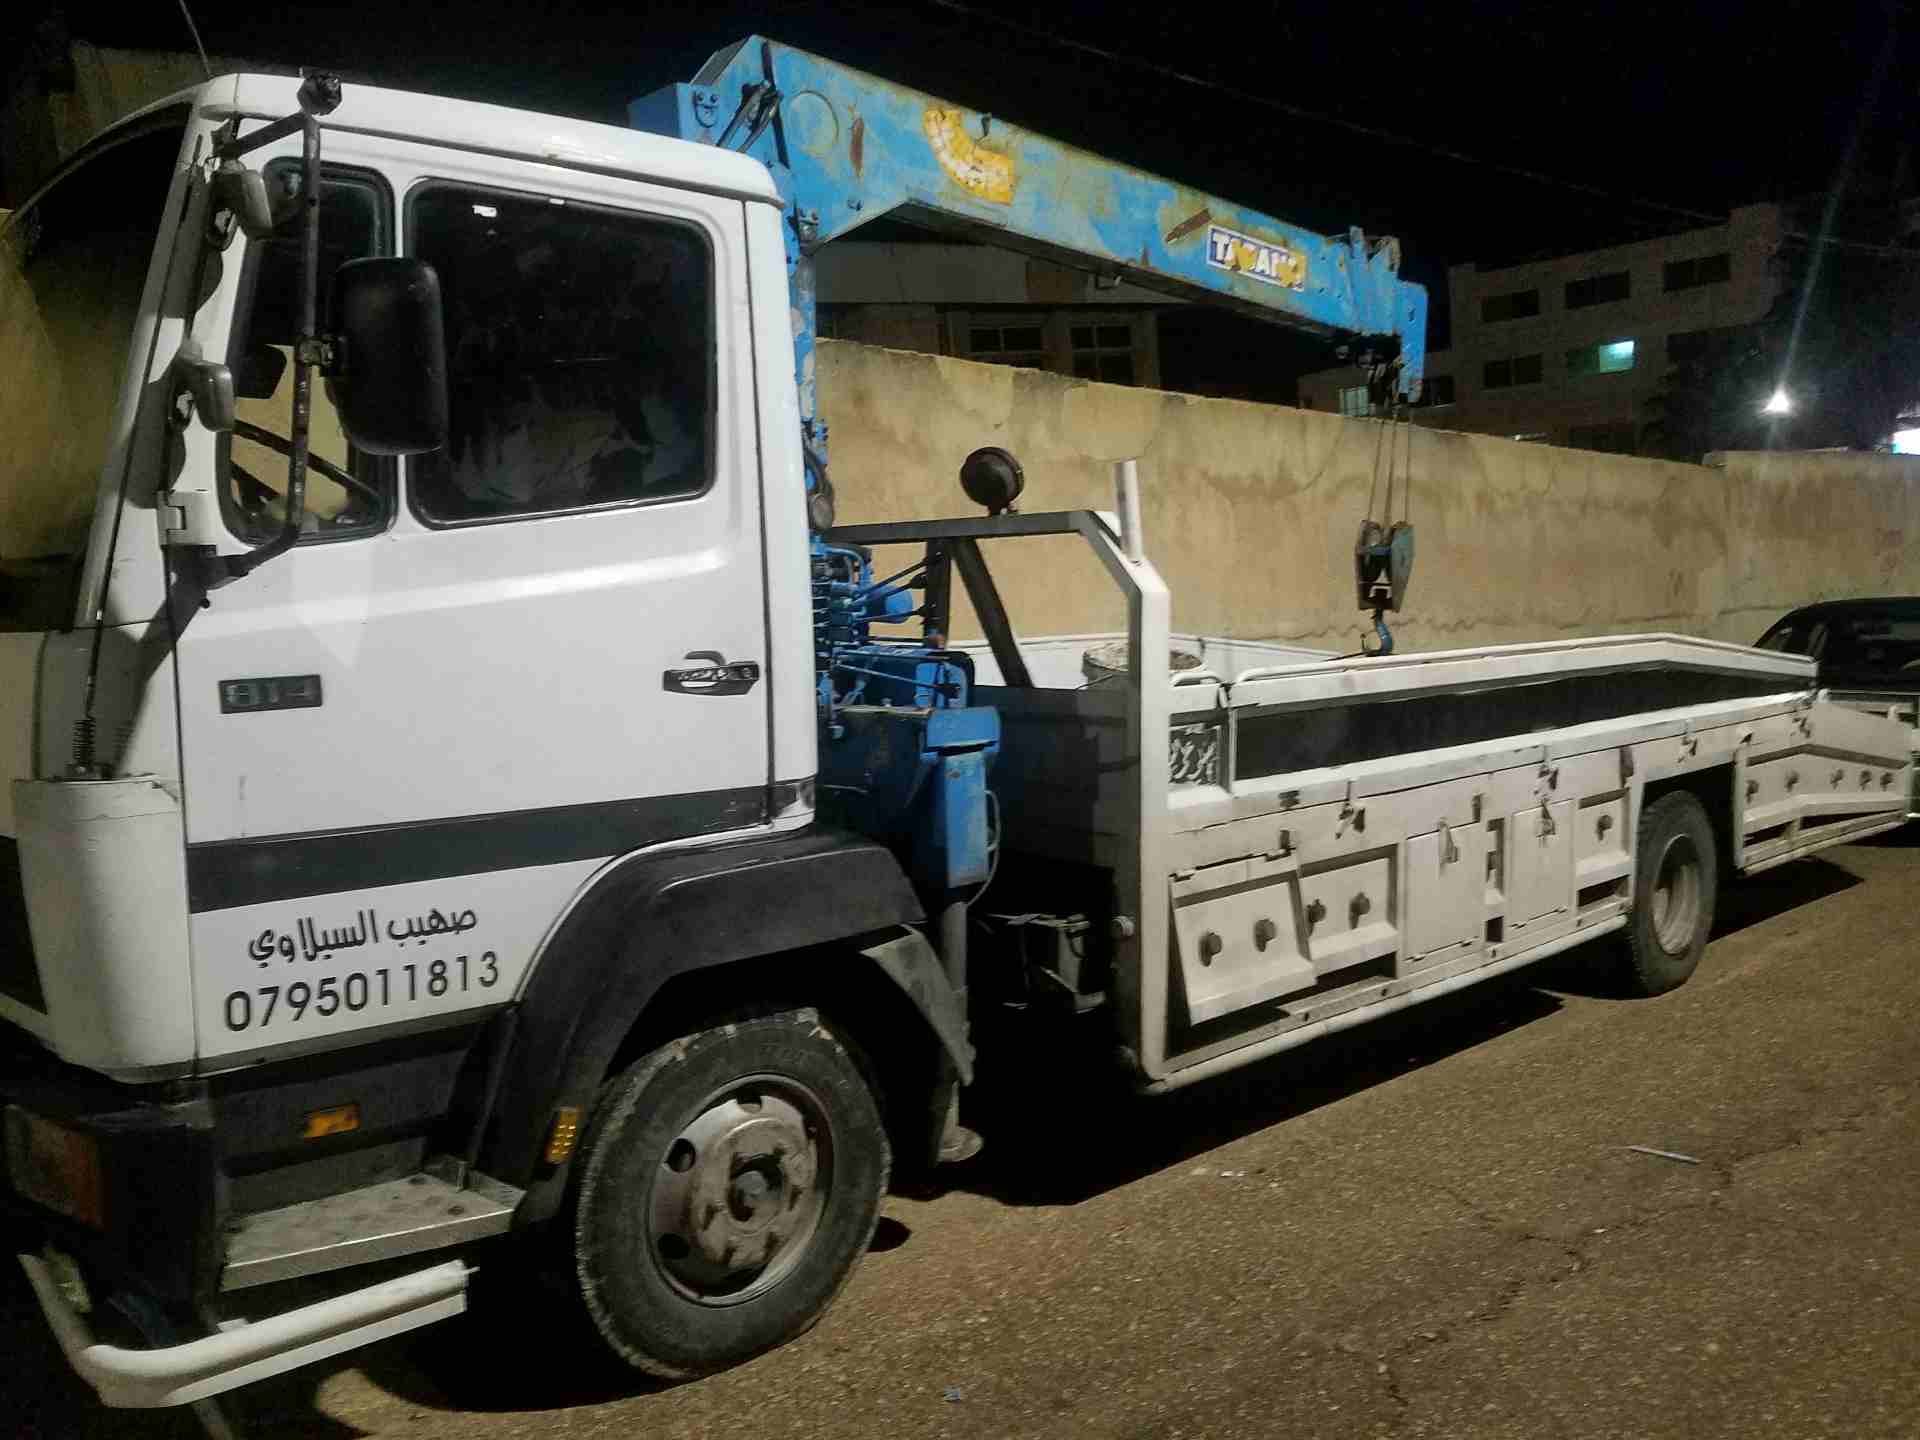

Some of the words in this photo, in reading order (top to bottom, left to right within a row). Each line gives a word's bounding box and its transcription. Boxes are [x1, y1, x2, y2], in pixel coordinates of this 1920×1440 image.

[248, 908, 380, 969] السيلاوي
[387, 907, 478, 948] صهيب
[223, 950, 500, 1032] 0795011813
